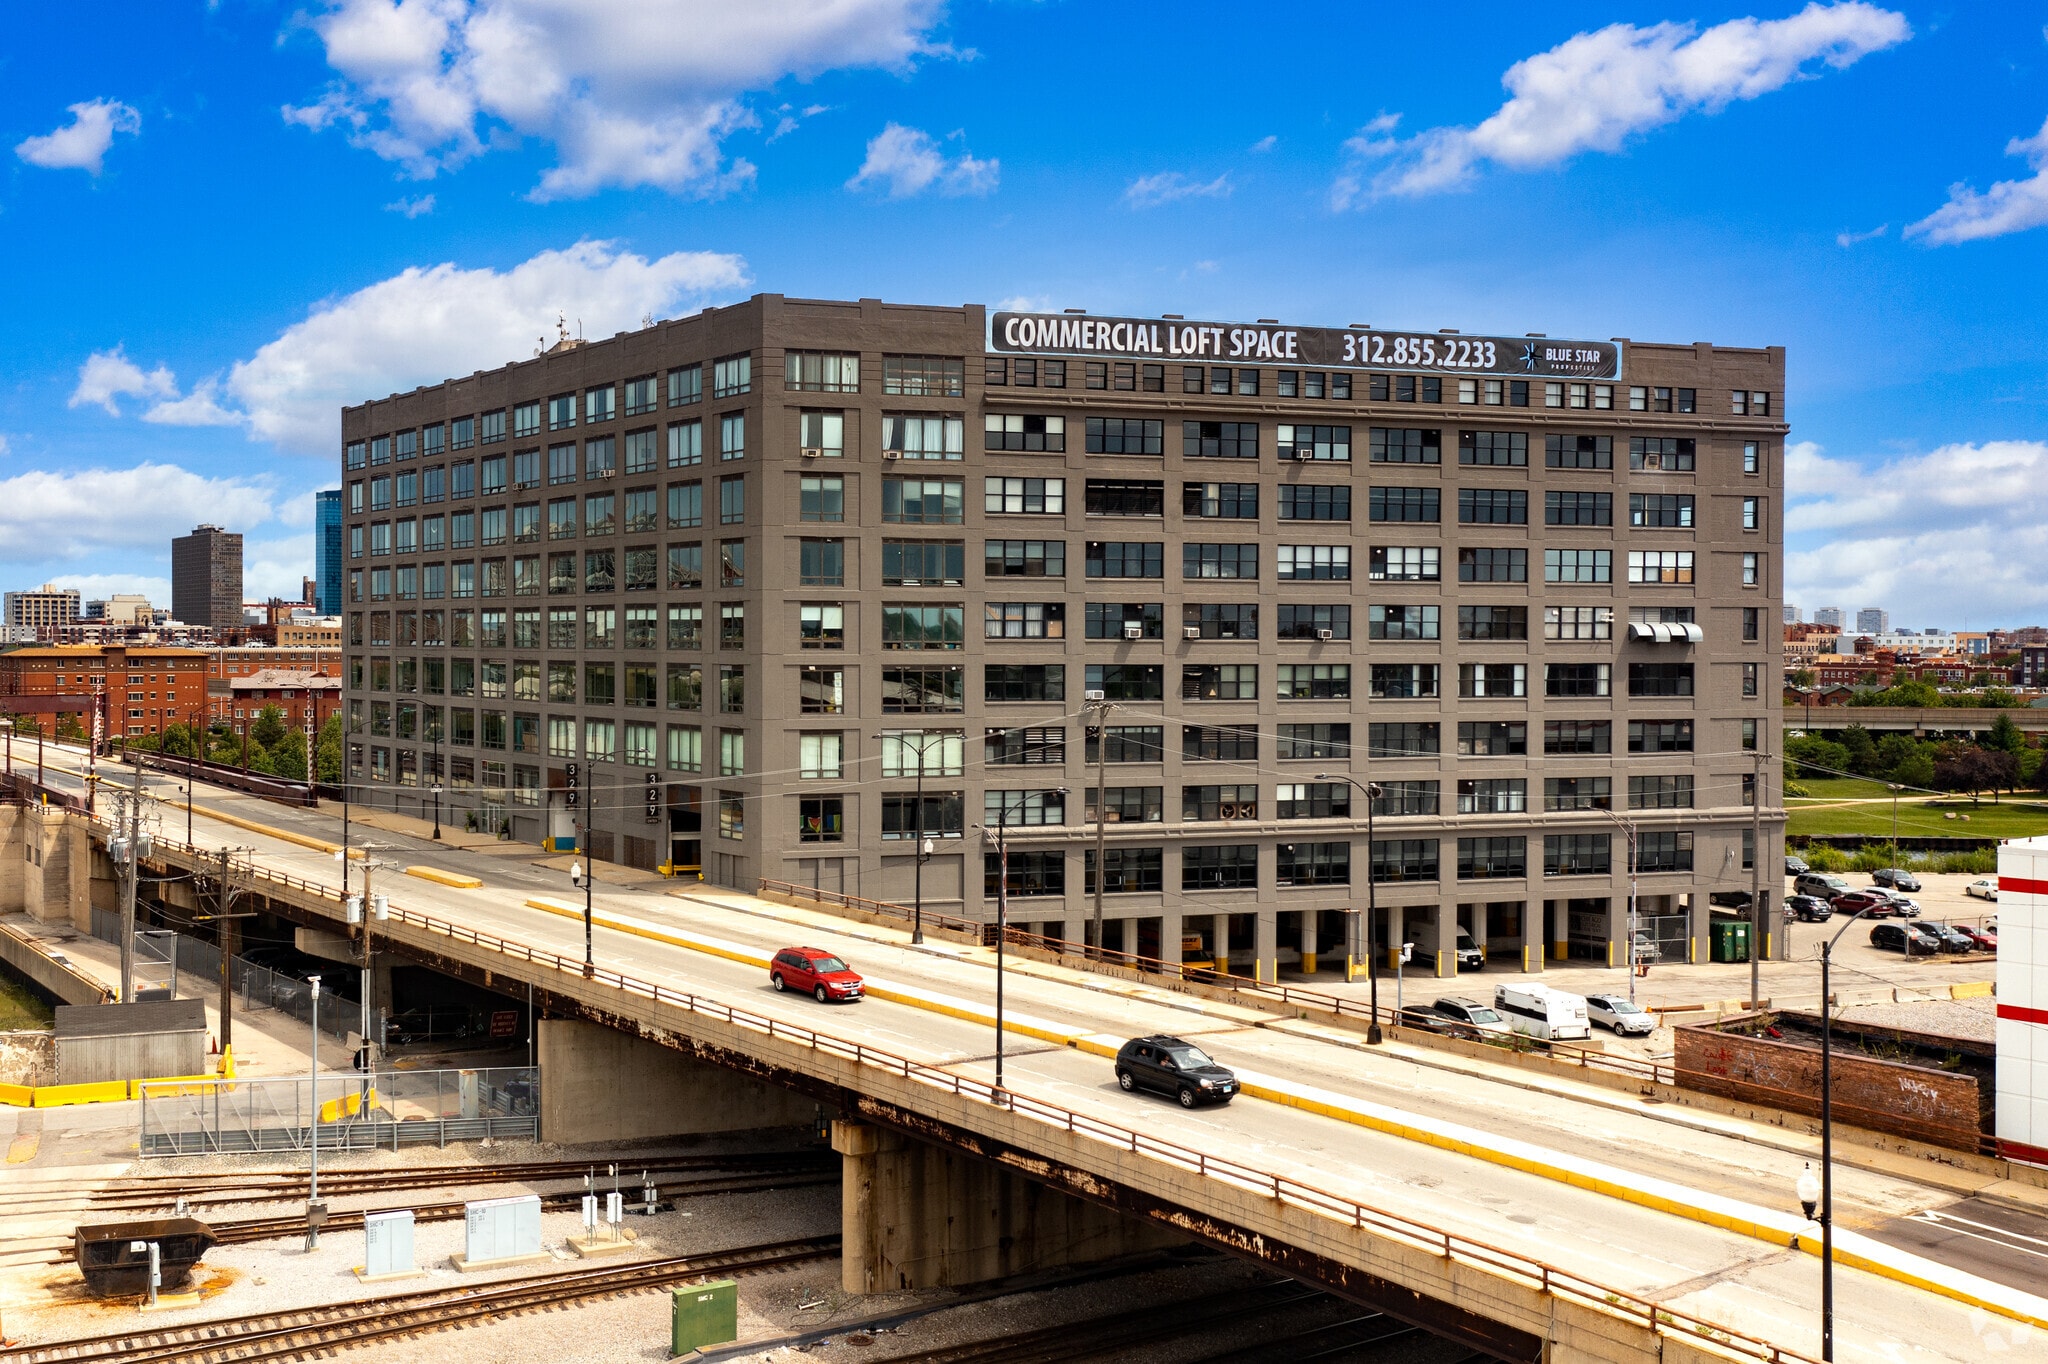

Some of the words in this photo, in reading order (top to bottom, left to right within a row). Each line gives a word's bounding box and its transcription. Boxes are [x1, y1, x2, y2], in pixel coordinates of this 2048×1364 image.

[1005, 317, 1163, 353] COMMERCIAL
[1169, 326, 1225, 355] LOFT
[1229, 328, 1298, 359] SPACE
[1342, 334, 1496, 368] 312.855.2233
[1546, 348, 1572, 362] BLUE
[1575, 349, 1600, 363] STAR
[1551, 363, 1595, 371] PROPERTIES
